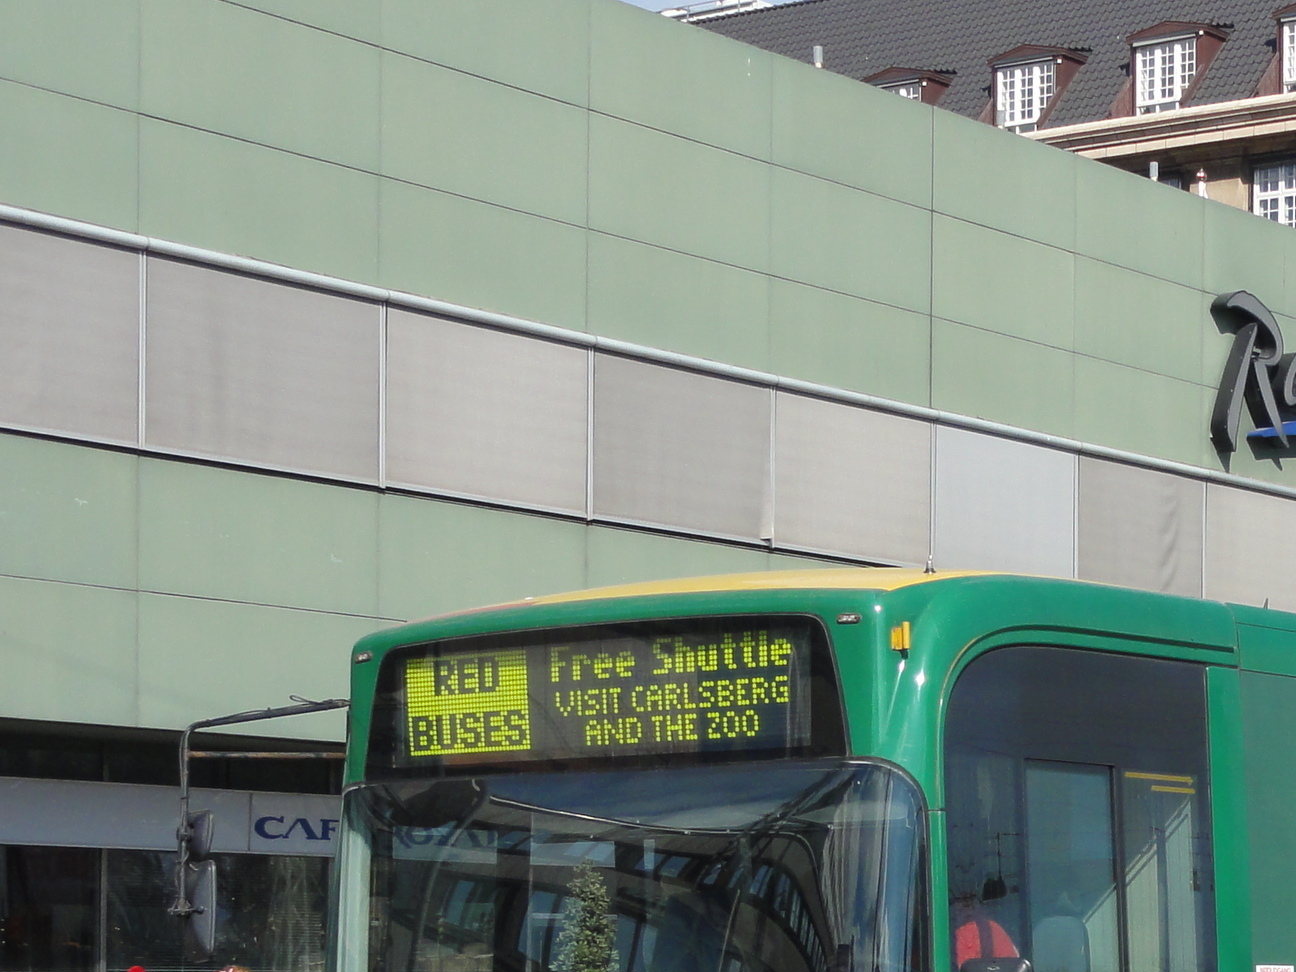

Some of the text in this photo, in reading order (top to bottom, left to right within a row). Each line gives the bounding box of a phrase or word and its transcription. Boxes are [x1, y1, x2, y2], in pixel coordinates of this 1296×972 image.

[551, 630, 792, 682] Free Shuttle
[434, 657, 500, 698] RED
[555, 675, 789, 716] VISIT CARLSBERG
[411, 711, 528, 750] BUSES
[586, 709, 759, 745] AND THE ZOO
[254, 816, 339, 841] CAF
